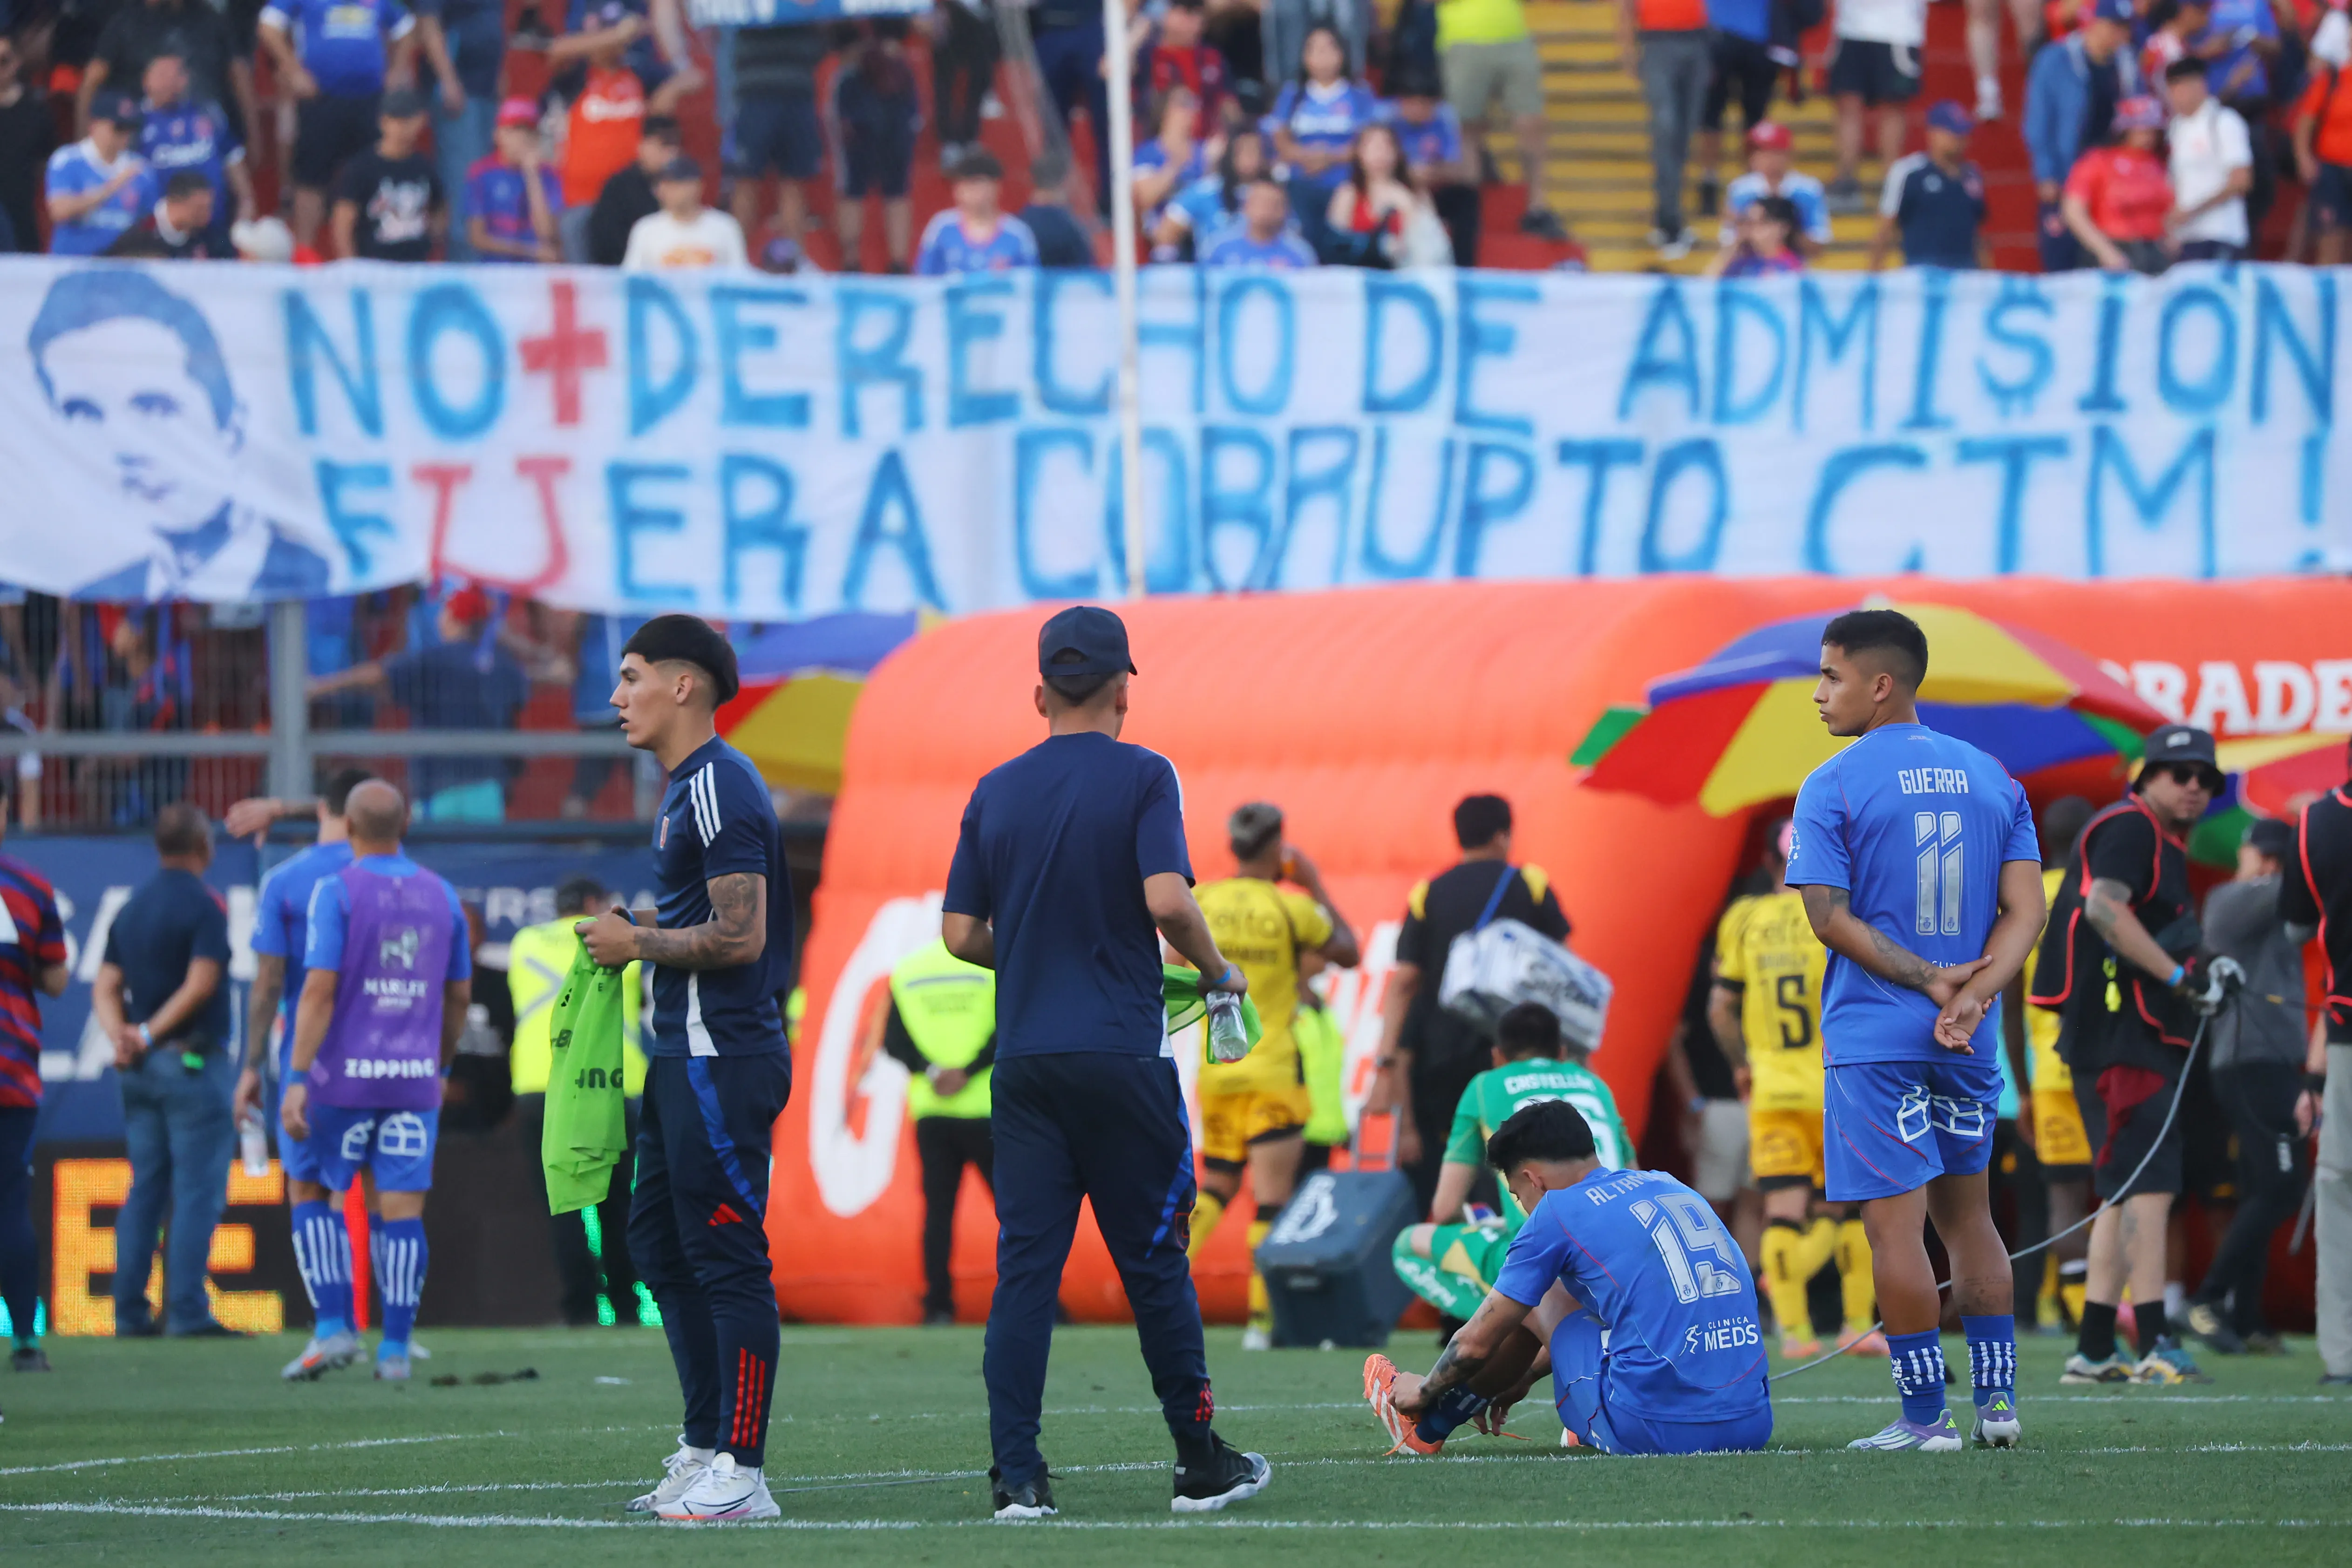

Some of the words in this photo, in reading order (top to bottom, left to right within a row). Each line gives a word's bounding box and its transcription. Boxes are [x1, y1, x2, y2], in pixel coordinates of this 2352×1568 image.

[1362, 276, 1542, 437] DE
[316, 448, 947, 612] FUERA
[2100, 658, 2352, 735] RADE
[1898, 767, 1969, 794] GUERRA
[1914, 811, 1963, 936] 11
[1777, 975, 1811, 1049] 5
[1629, 1193, 1741, 1303] 19
[1704, 1324, 1759, 1352] MEDS
[1708, 1316, 1749, 1330] CLINICA
